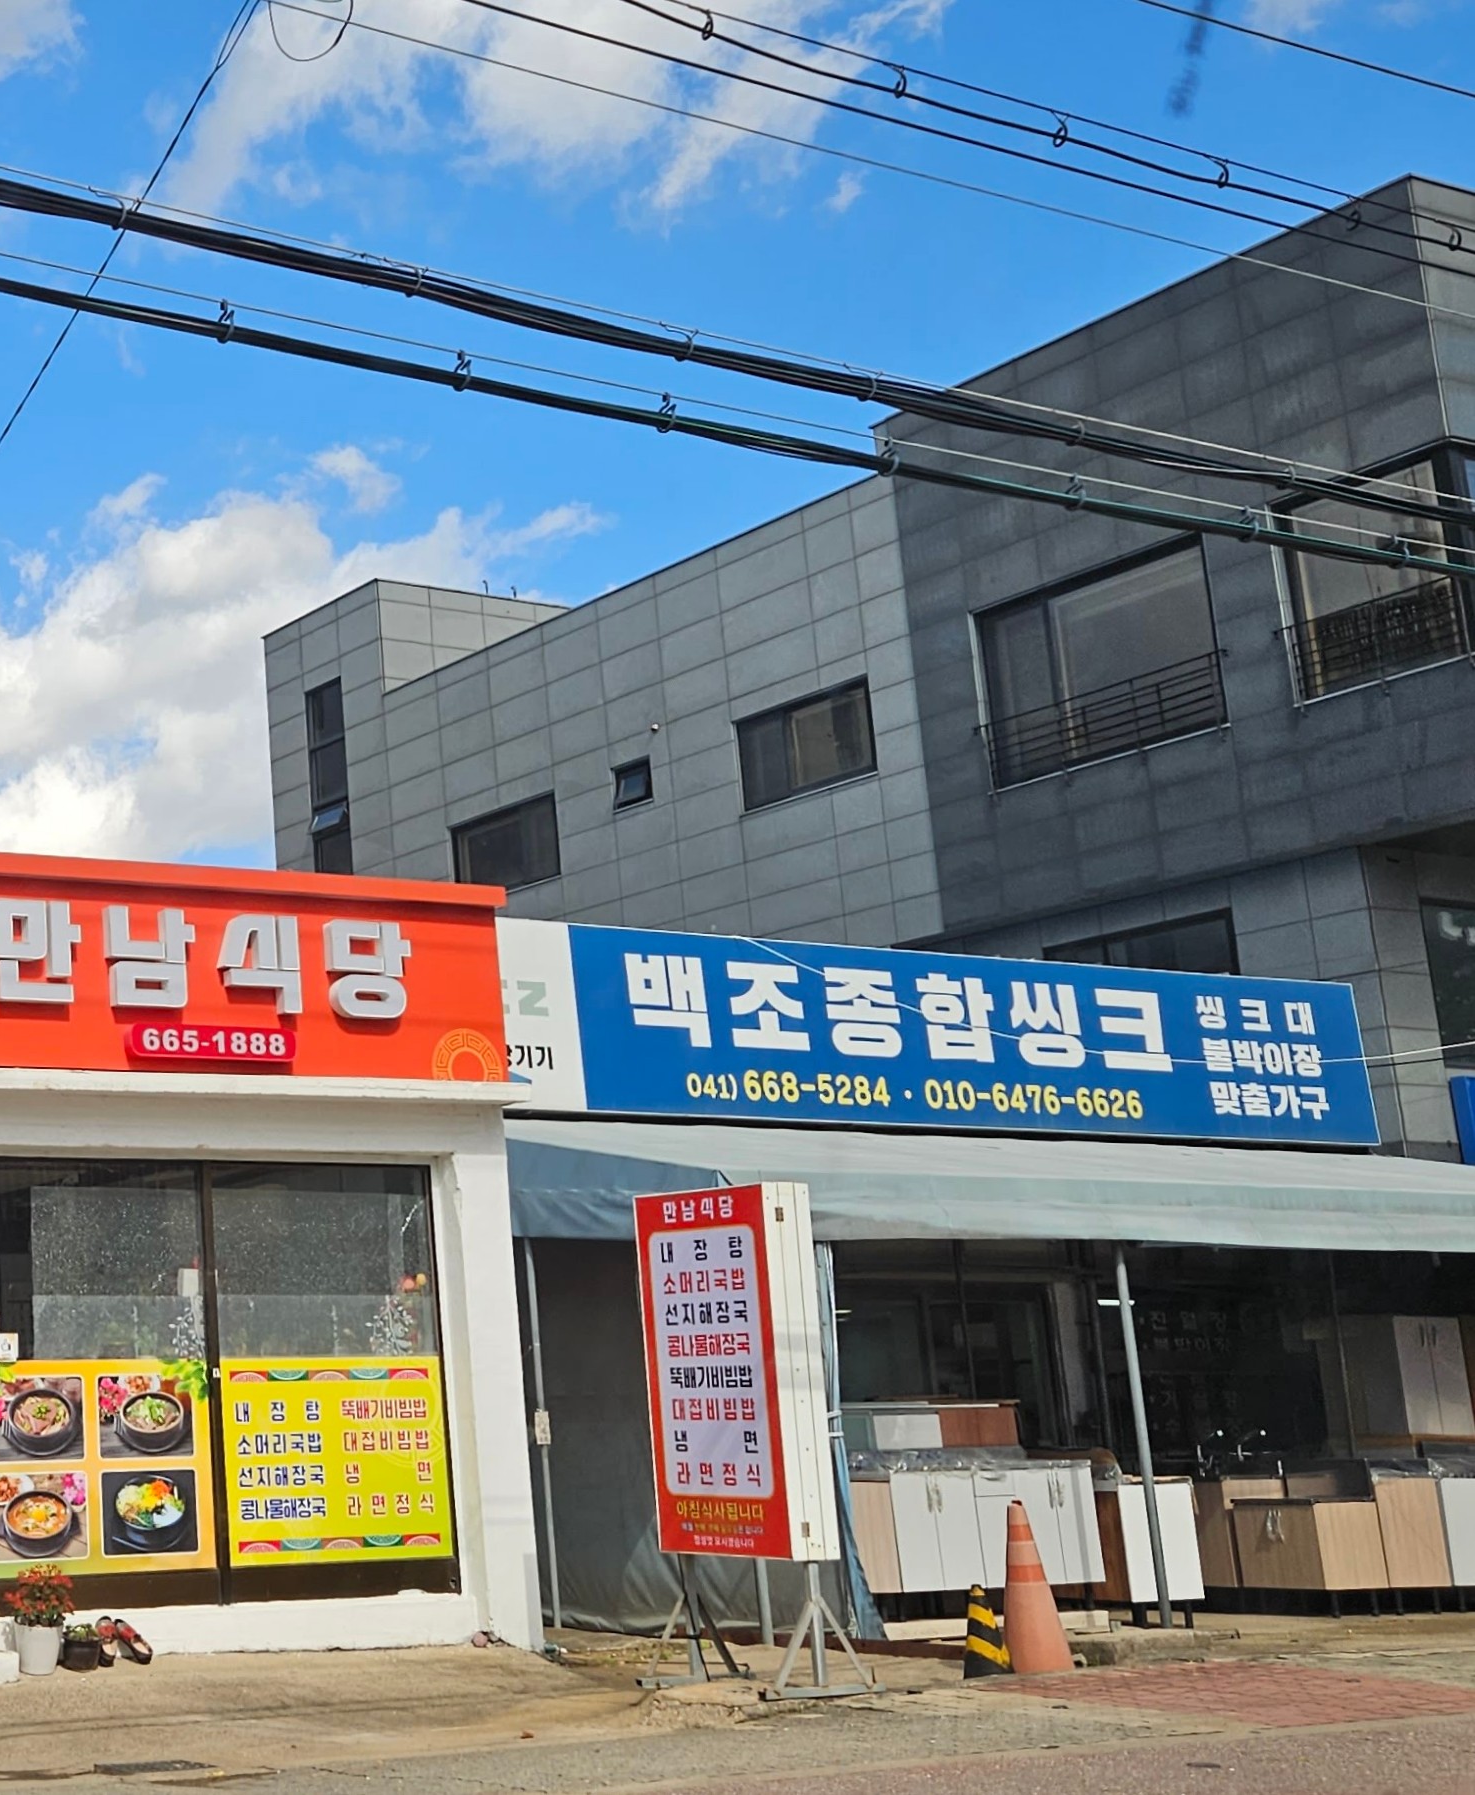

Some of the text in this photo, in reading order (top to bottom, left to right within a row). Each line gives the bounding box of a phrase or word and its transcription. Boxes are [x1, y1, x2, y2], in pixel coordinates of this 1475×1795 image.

[624, 952, 1174, 1073] 백조종합씽크
[1195, 995, 1316, 1036] 씽크대
[141, 1027, 287, 1057] 665-1888
[686, 1069, 1144, 1121] 041) 668-5284 010-6476-6626
[1209, 1080, 1331, 1121] 맞춤가구
[662, 1195, 734, 1224] 만남식당
[660, 1235, 743, 1264] 내장탕
[663, 1267, 746, 1296] 소머리국밥
[665, 1300, 749, 1327] 선지해장국
[667, 1332, 751, 1358] 콩나물해장국
[669, 1365, 753, 1390] 뚝배기비빔밥
[235, 1398, 428, 1425] 내장탕 뚝배기비빔밥
[672, 1398, 756, 1422] 대접비빔밥
[237, 1430, 431, 1457] 소머리국밥 대접비빔밥
[238, 1463, 325, 1488] 선지해장국
[676, 1461, 762, 1488] 라면정식
[240, 1492, 436, 1522] 콩나물해장국 라면정식
